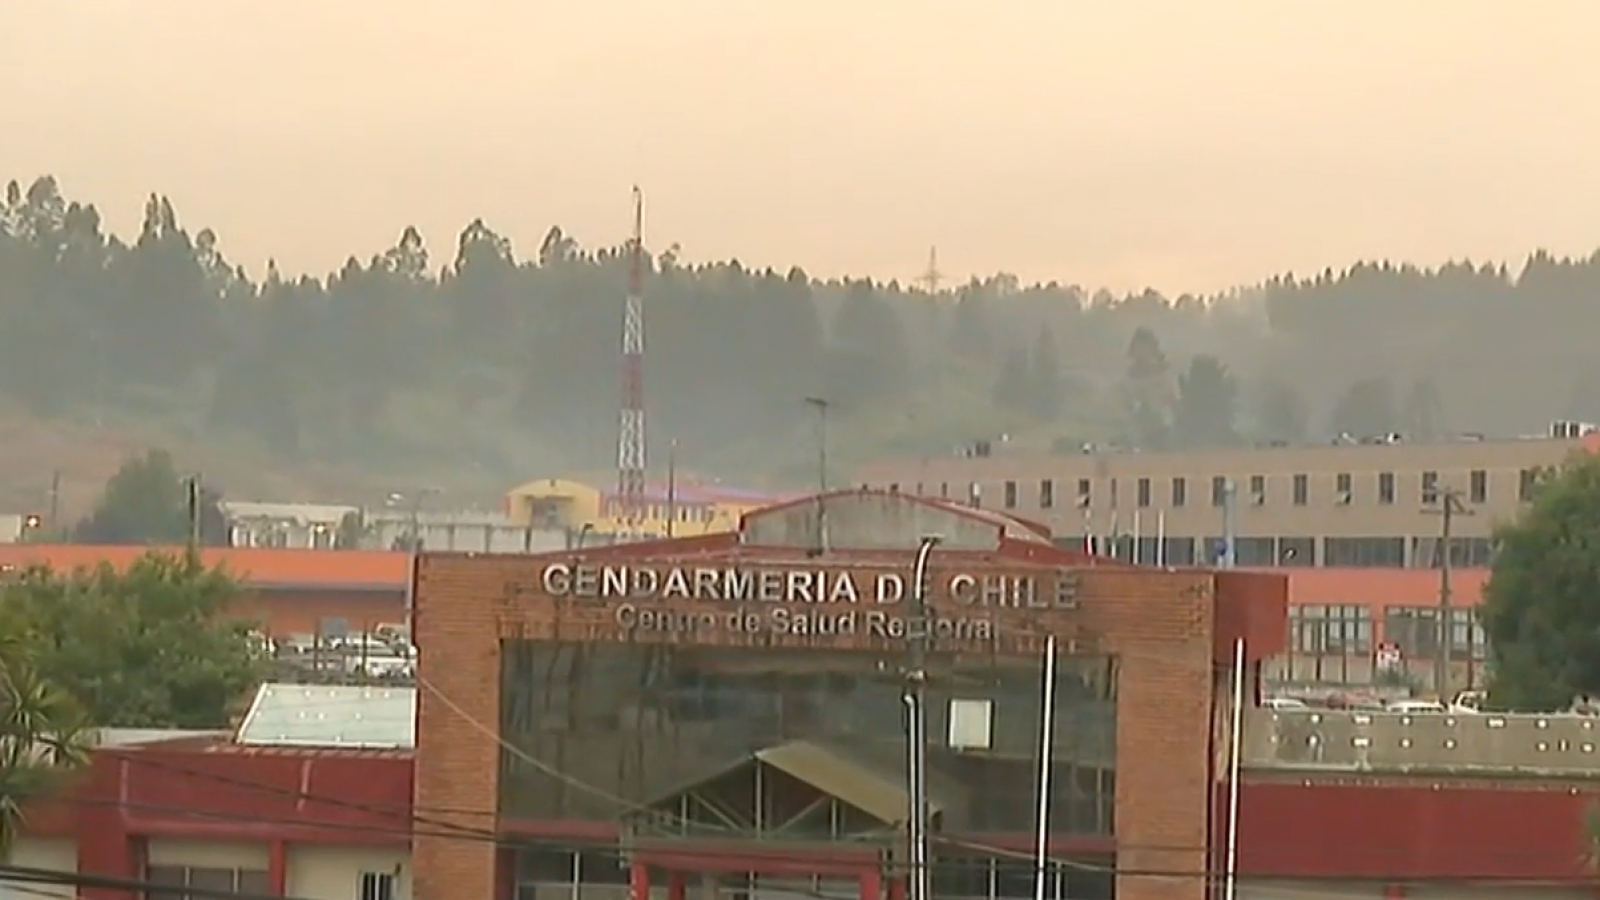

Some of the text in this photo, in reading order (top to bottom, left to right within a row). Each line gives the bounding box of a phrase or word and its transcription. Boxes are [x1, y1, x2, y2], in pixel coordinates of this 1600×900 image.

[542, 563, 858, 603] GENDARMERIA
[950, 574, 1078, 609] CHILE
[615, 602, 1000, 641] Centro de Salud Reional
